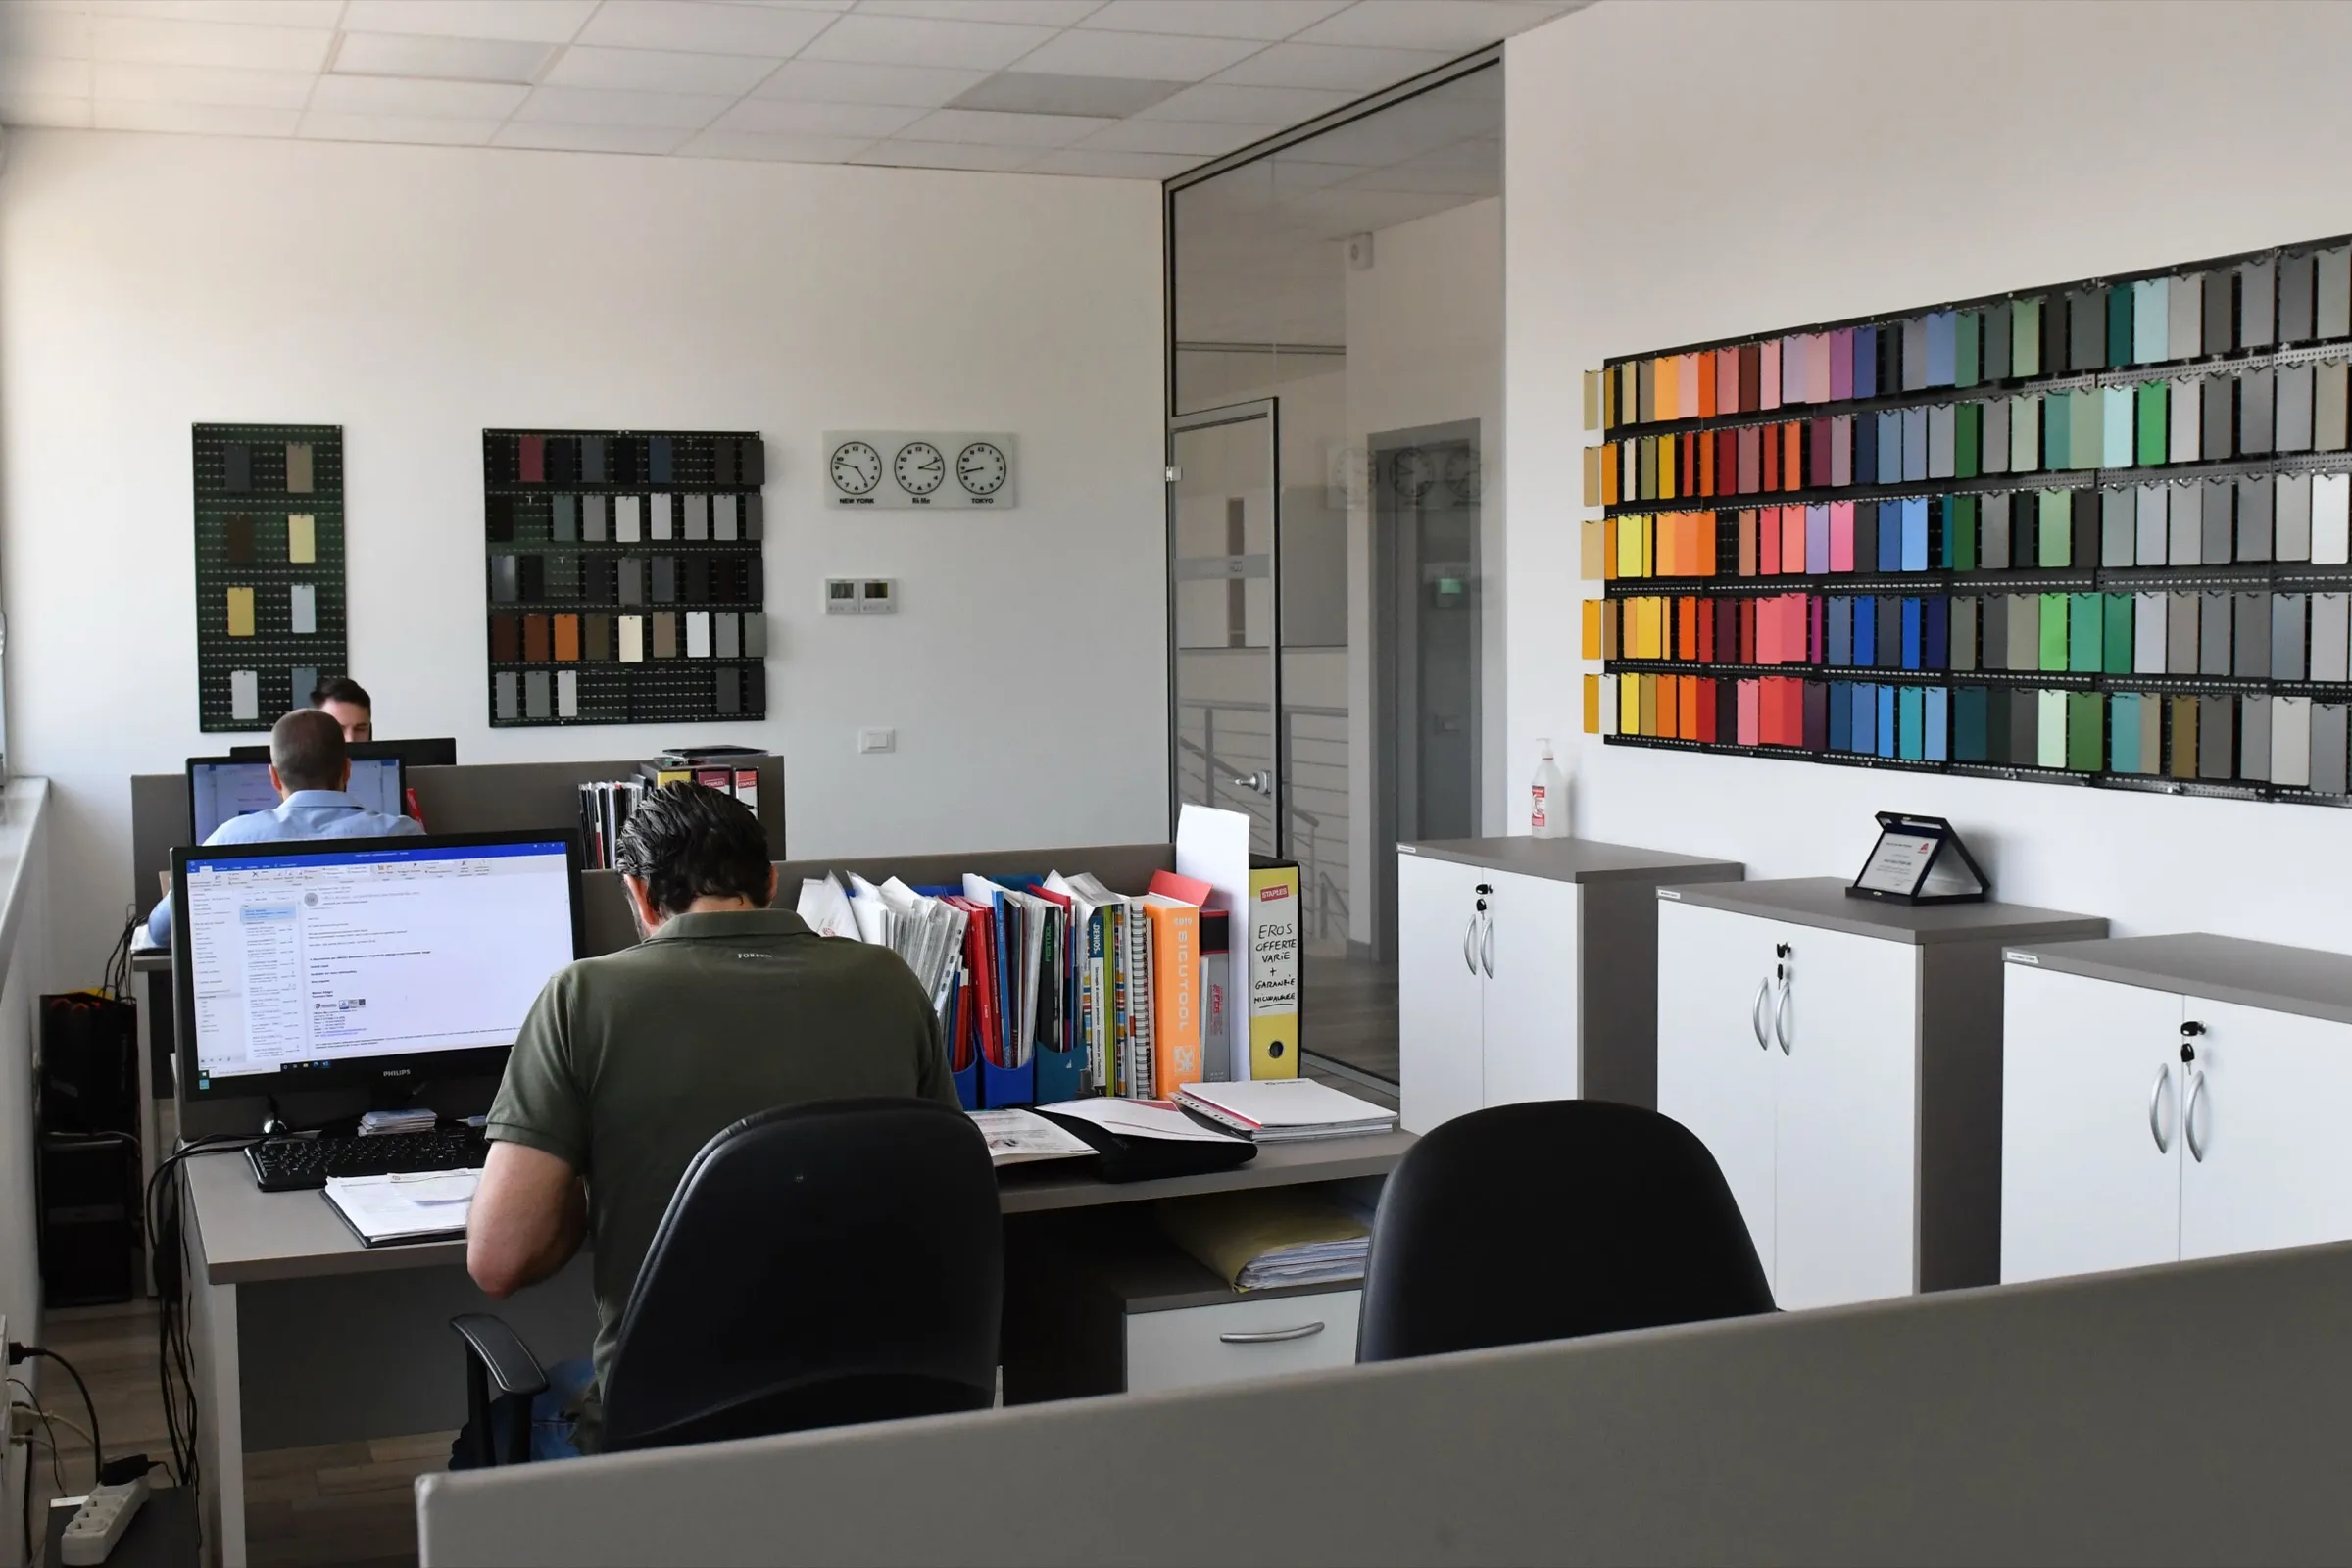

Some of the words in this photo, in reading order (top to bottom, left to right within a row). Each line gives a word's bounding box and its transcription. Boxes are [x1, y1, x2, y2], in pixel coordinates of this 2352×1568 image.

[1262, 887, 1287, 898] STAPLES
[1259, 923, 1292, 939] EROS
[1256, 939, 1297, 951] OFFERTE
